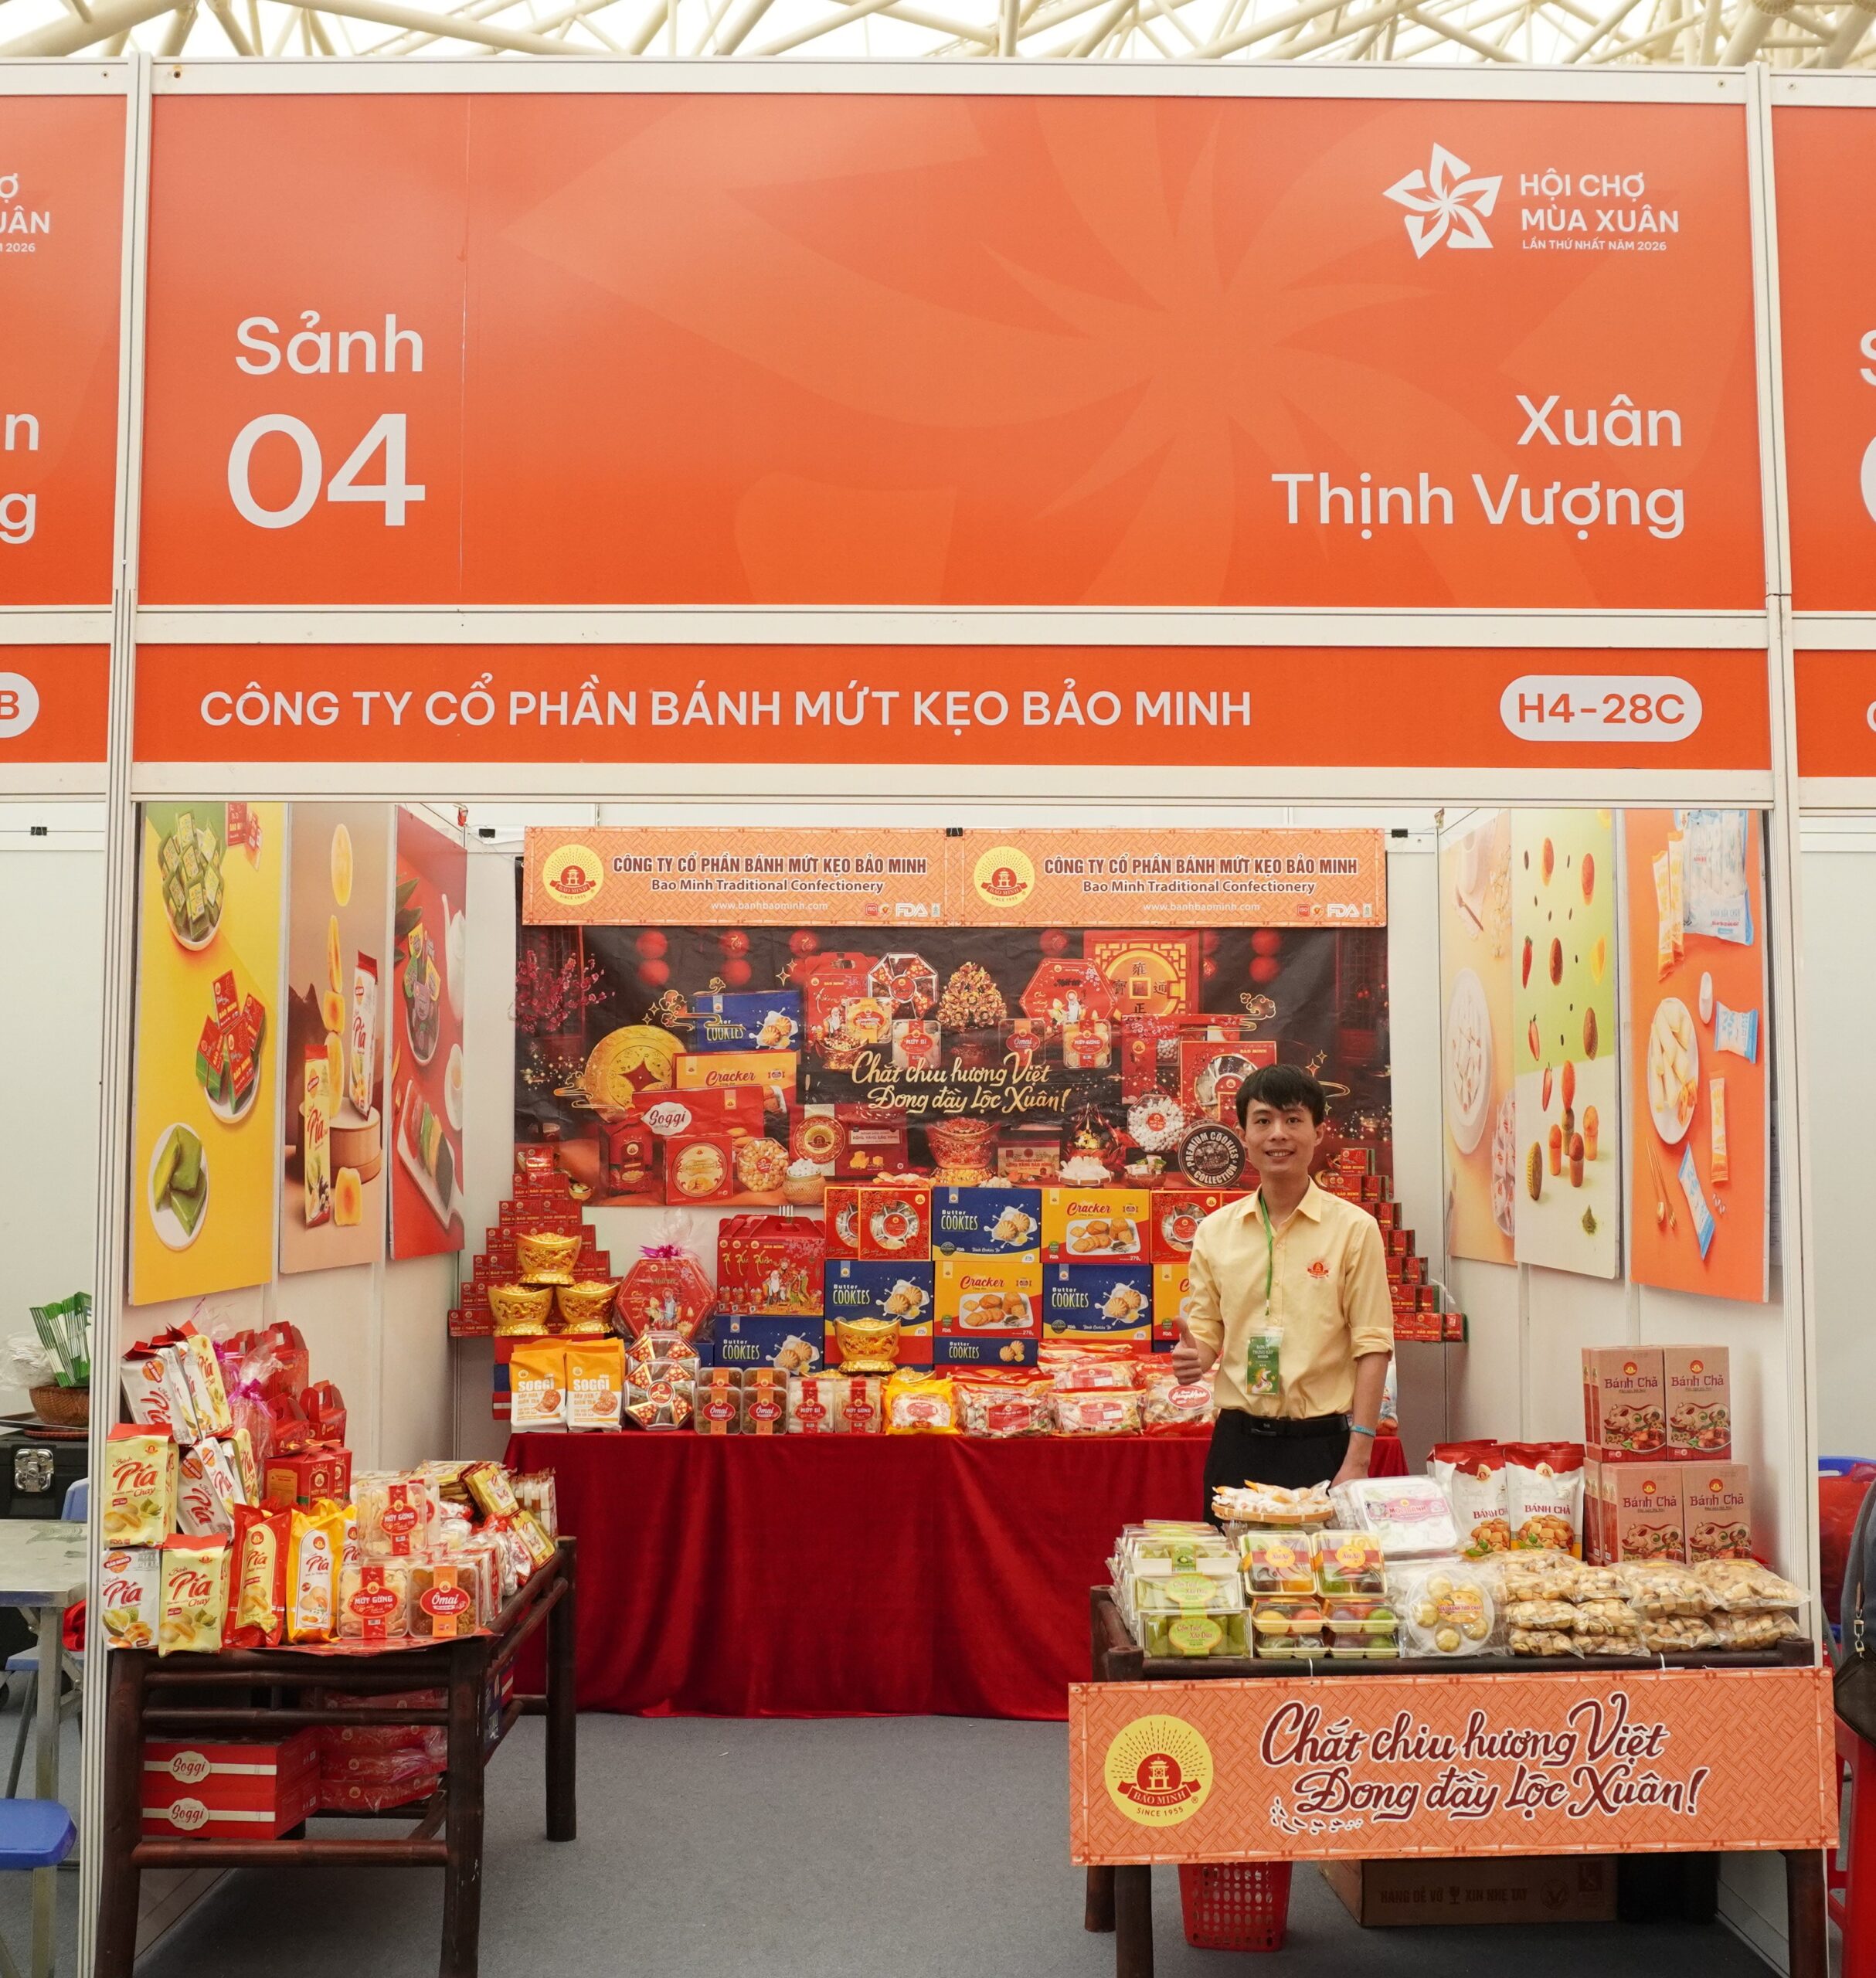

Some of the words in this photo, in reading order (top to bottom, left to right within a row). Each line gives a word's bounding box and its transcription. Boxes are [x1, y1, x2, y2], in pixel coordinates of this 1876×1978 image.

[1520, 167, 1572, 201] HỘI
[1579, 172, 1645, 202] CHỢ
[1521, 204, 1588, 232] MÙA
[1596, 204, 1680, 233] XUÂN
[5, 242, 36, 253] 2026
[1549, 237, 1573, 250] THỨ
[1575, 236, 1606, 250] NHẤT
[1609, 238, 1635, 251] NĂM
[1637, 240, 1667, 251] 2026
[236, 310, 424, 376] Sảnh
[1516, 393, 1682, 447] Xuân
[228, 413, 426, 530] 04
[1272, 471, 1454, 540] Thịnh
[1472, 472, 1685, 540] Vượng
[200, 681, 340, 727] CÔNG
[352, 690, 413, 726] TY
[425, 671, 495, 727] CỔ
[509, 674, 632, 727] PHẦN
[651, 679, 780, 727] BÁNH
[796, 679, 899, 727] MỨT
[914, 690, 1009, 737] KẸO
[1023, 678, 1122, 727] BẢO
[1136, 690, 1252, 726] MINH
[1517, 692, 1685, 725] H4-28C
[613, 853, 652, 873] CÔNG
[657, 857, 673, 872] TY
[678, 851, 697, 873] CỔ
[702, 852, 740, 873] PHẦN
[745, 855, 784, 873] BÁNH
[788, 855, 819, 873] MỨT
[823, 857, 851, 876] KẸO
[855, 853, 884, 874] BẢO
[888, 858, 926, 874] MINH
[1044, 856, 1083, 874] CÔNG
[1088, 858, 1104, 874] TY
[1109, 853, 1128, 874] CỔ
[1132, 854, 1171, 874] PHẦN
[1176, 855, 1215, 874] BÁNH
[1219, 855, 1250, 874] MỨT
[1254, 858, 1282, 877] KẸO
[1286, 854, 1315, 874] BẢO
[1319, 858, 1358, 874] MINH
[651, 879, 677, 891] Bao
[681, 879, 713, 891] Minh
[717, 879, 787, 891] Traditional
[790, 879, 884, 894] Confectionery
[1083, 881, 1108, 892] Bao
[1112, 880, 1145, 892] Minh
[1148, 880, 1219, 892] Traditional
[1222, 880, 1315, 895] Confectionery
[896, 902, 929, 918] FDA
[1327, 902, 1359, 918] FDA
[851, 1051, 903, 1083] Chắt
[906, 1058, 948, 1083] chiu
[950, 1056, 1008, 1087] hương
[1003, 1048, 1052, 1086] Việt
[705, 1070, 756, 1086] Cracker
[931, 1086, 967, 1113] đầy
[970, 1085, 1002, 1114] Lộc
[1001, 1086, 1072, 1114] Xuân!
[649, 1110, 687, 1128] Soggi
[1185, 1132, 1209, 1167] PREMIUM
[1210, 1131, 1239, 1160] COOKIES
[1194, 1164, 1239, 1184] COLLECTION
[1066, 1202, 1112, 1216] Cracker
[940, 1215, 978, 1231] COOKIES
[960, 1275, 1005, 1290] Cracker
[833, 1289, 870, 1305] COOKIES
[1052, 1293, 1089, 1308] COOKIES
[722, 1344, 760, 1360] COOKIES
[949, 1346, 980, 1359] COOKIES
[518, 1378, 554, 1392] SOGGI
[573, 1378, 610, 1392] SOGGI
[1604, 1377, 1633, 1389] Bánh
[1637, 1375, 1658, 1388] Chả
[1670, 1375, 1700, 1387] Bánh
[1704, 1374, 1725, 1386] Chả
[111, 1461, 159, 1492] Pía
[134, 1487, 156, 1497] Chay
[1690, 1494, 1719, 1506] Bánh
[1723, 1493, 1745, 1505] Chả
[182, 1487, 216, 1524] Pía
[1524, 1502, 1551, 1513] BÁNH
[1554, 1505, 1571, 1514] CHẢ
[1623, 1496, 1652, 1508] Bánh
[1656, 1495, 1677, 1507] Chả
[1473, 1508, 1497, 1520] BÁNH
[246, 1551, 268, 1567] Pía
[306, 1555, 329, 1572] Pía
[102, 1579, 144, 1608] Pía
[168, 1571, 215, 1601] Pía
[188, 1596, 210, 1607] Chay
[354, 1596, 371, 1605] MỨT
[431, 1593, 459, 1606] Ômai
[1263, 1701, 1367, 1765] Chắt
[1371, 1711, 1458, 1761] chiu
[1462, 1710, 1578, 1768] hương
[1568, 1692, 1669, 1765] Việt
[172, 1757, 207, 1776] Soggi
[1157, 1789, 1186, 1805] MINH
[1294, 1766, 1420, 1823] Đong
[1426, 1766, 1497, 1820] đầy
[1505, 1765, 1568, 1820] Lộc
[1567, 1765, 1708, 1817] Xuân!
[170, 1803, 204, 1823] Soggi
[1136, 1806, 1161, 1817] SINCE
[1163, 1806, 1184, 1817] 1955
